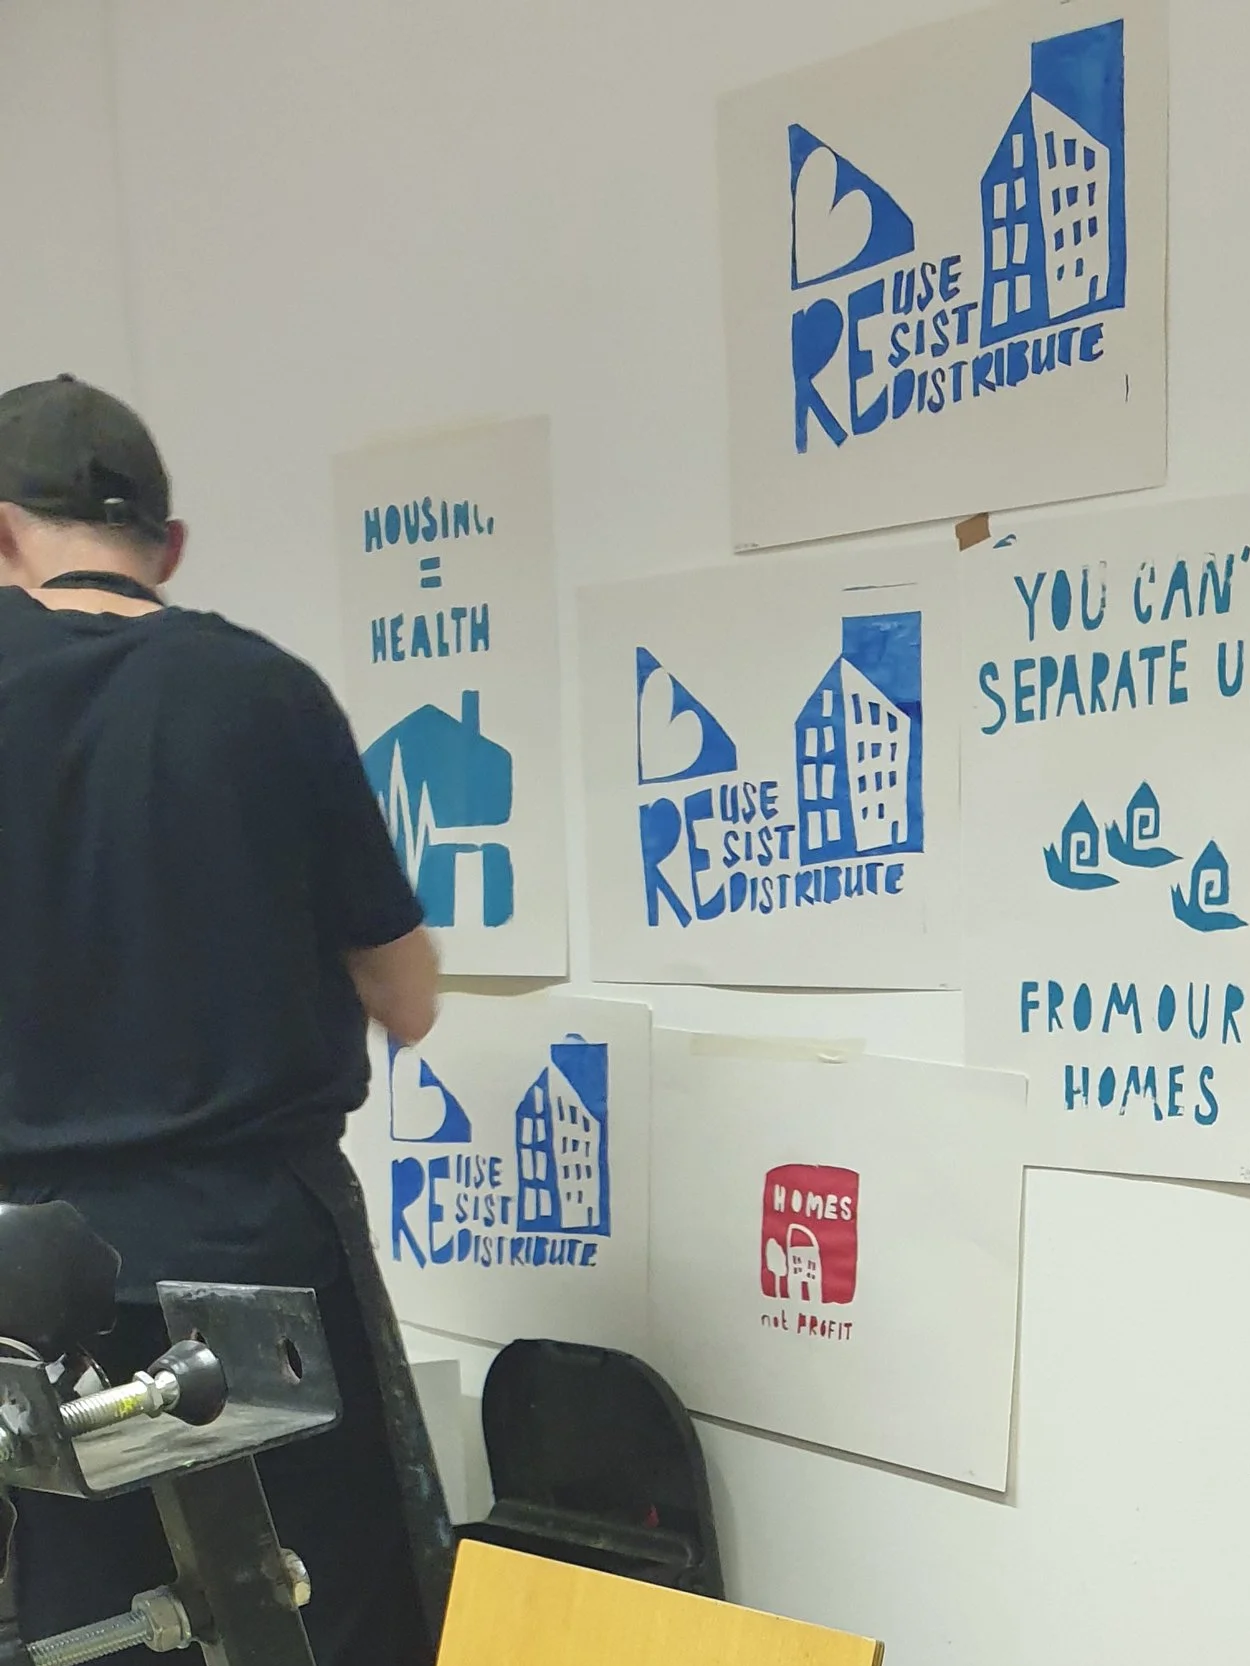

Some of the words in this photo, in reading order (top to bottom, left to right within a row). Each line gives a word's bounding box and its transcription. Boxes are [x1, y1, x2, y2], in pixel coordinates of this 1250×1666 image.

[892, 254, 962, 316] USE
[888, 302, 978, 368] SIST
[891, 323, 1104, 419] DISTRIBUTE
[1013, 560, 1107, 642] YOU
[371, 603, 490, 664] HEALTH
[978, 638, 1189, 736] SEPARATE
[719, 780, 780, 824] USE
[722, 824, 797, 869] SIST
[728, 863, 906, 916] DISTRIBUTE
[1020, 979, 1143, 1034] FROM
[1157, 982, 1246, 1044] OUR
[1064, 1064, 1219, 1127] HOMES
[455, 1193, 514, 1228] SIST
[773, 1184, 853, 1221] HOMES
[457, 1228, 598, 1268] DISTRIBUTE
[760, 1309, 789, 1331] not
[797, 1312, 853, 1341] PROFIT
